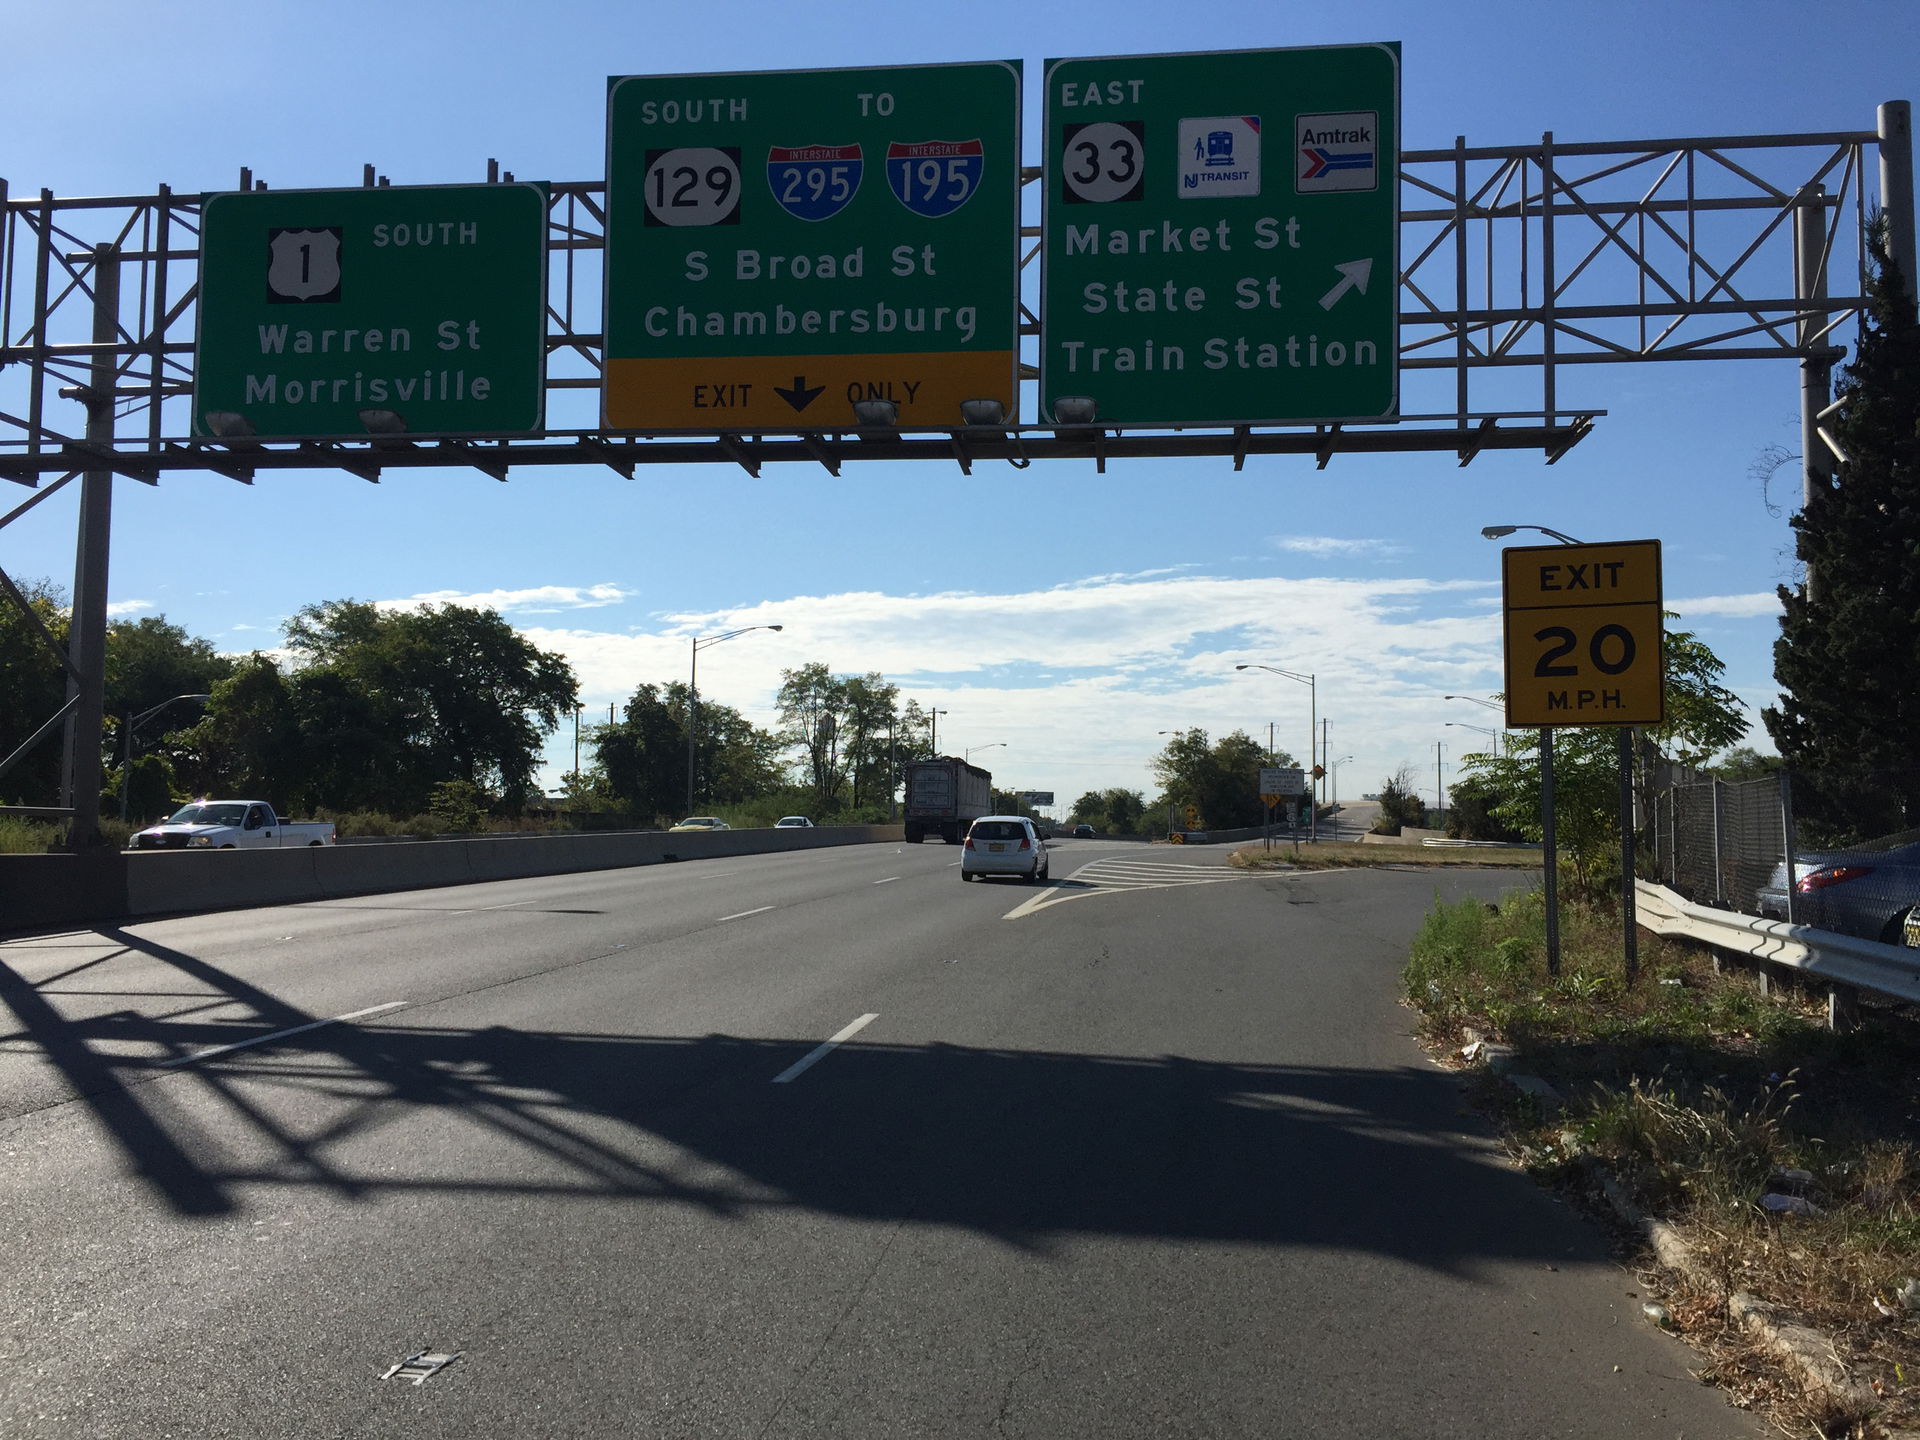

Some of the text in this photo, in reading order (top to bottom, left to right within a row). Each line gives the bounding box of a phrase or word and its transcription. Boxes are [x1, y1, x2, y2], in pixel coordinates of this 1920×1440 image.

[857, 92, 895, 117] TO
[1062, 79, 1144, 107] EAST
[641, 98, 748, 125] SOUTH
[909, 145, 961, 156] INTERSTATE
[1301, 126, 1371, 146] Amtrak
[789, 149, 841, 161] INTERSTATE
[1071, 138, 1136, 185] 33
[653, 165, 733, 208] 129
[782, 166, 849, 203] 295
[902, 159, 970, 202] 195
[1200, 171, 1250, 182] TRANSIT
[373, 222, 478, 247] SOUTH
[1065, 216, 1301, 256] Market St
[300, 243, 311, 284] 1
[684, 243, 936, 281] S Broad St
[1082, 276, 1282, 314] State St
[258, 320, 481, 354] Warren St
[644, 301, 977, 343] Chambersburg
[1062, 334, 1377, 373] Train Station
[245, 369, 491, 405] Morrisville
[693, 381, 922, 408] EXIT ONLY
[1540, 562, 1625, 591] EXIT
[1533, 623, 1636, 678] 20
[1548, 689, 1626, 710] M.P.H.
